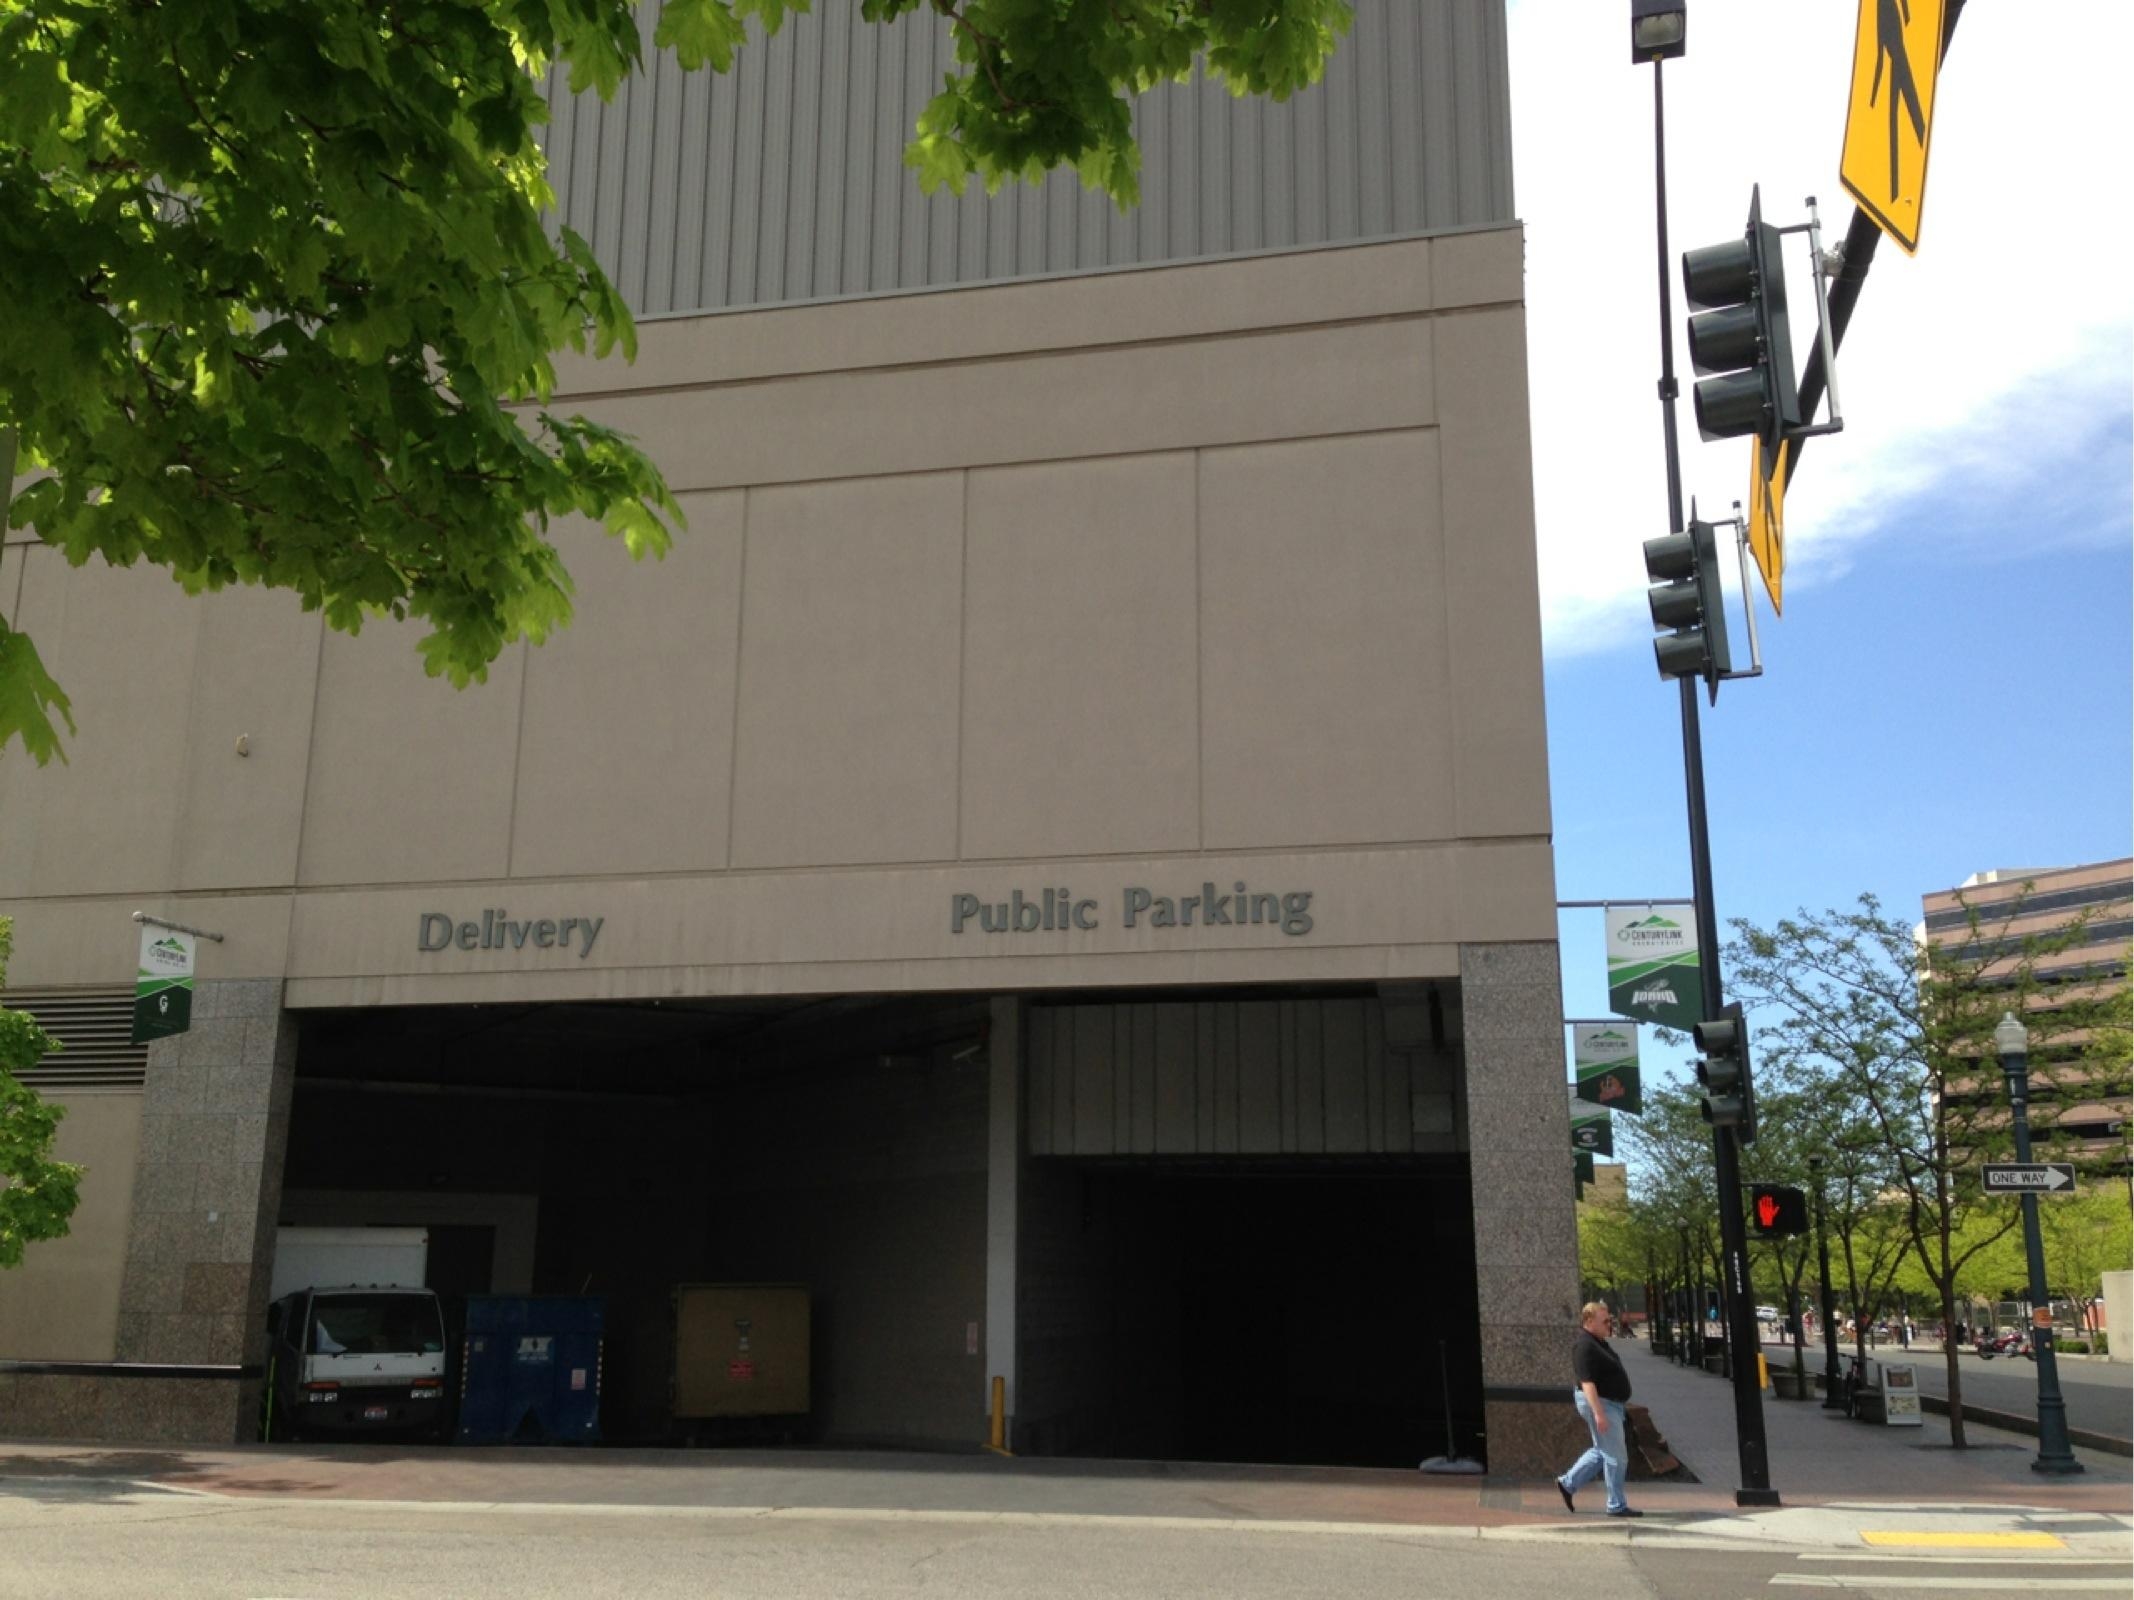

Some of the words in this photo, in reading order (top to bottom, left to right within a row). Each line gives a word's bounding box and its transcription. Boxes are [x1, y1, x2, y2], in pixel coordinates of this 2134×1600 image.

[418, 908, 604, 959] Delivery
[951, 888, 1099, 934] Public
[1122, 881, 1314, 936] Parking
[1992, 1172, 2017, 1184] ONE
[2021, 1172, 2046, 1183] WAY
